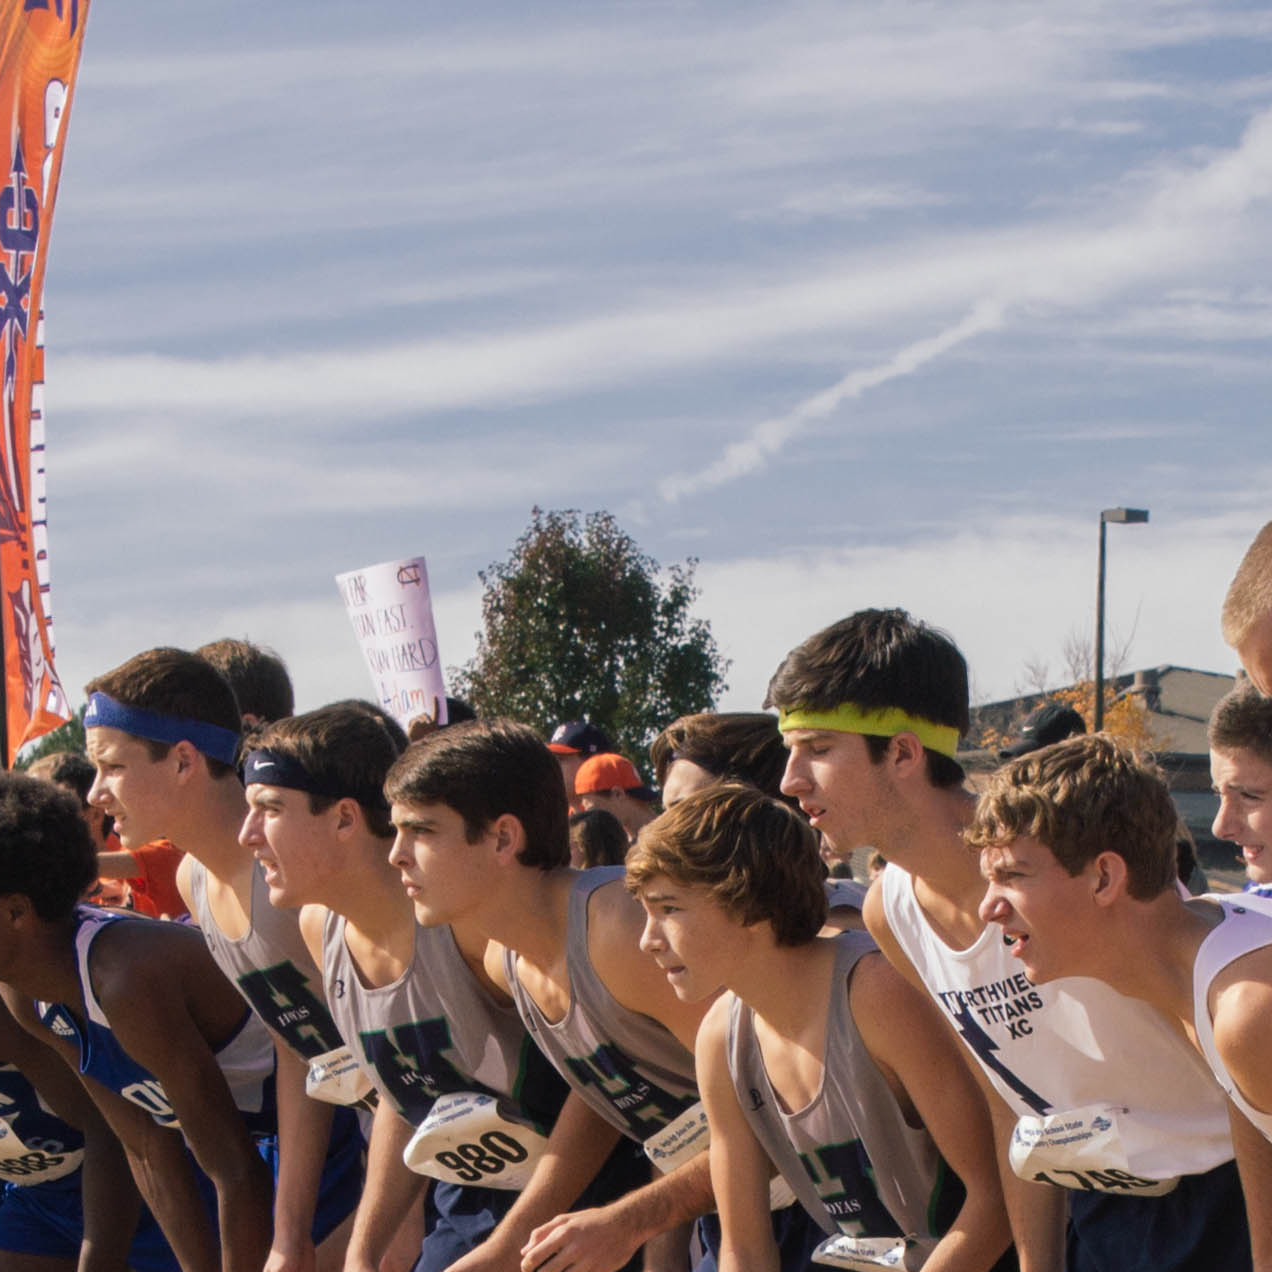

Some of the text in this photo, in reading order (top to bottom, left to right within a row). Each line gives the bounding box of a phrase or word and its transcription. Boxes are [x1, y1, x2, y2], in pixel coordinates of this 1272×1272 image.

[392, 639, 438, 671] HARD
[977, 991, 1043, 1025] TITANS
[1005, 1018, 1033, 1040] XC
[434, 1130, 529, 1182] 980
